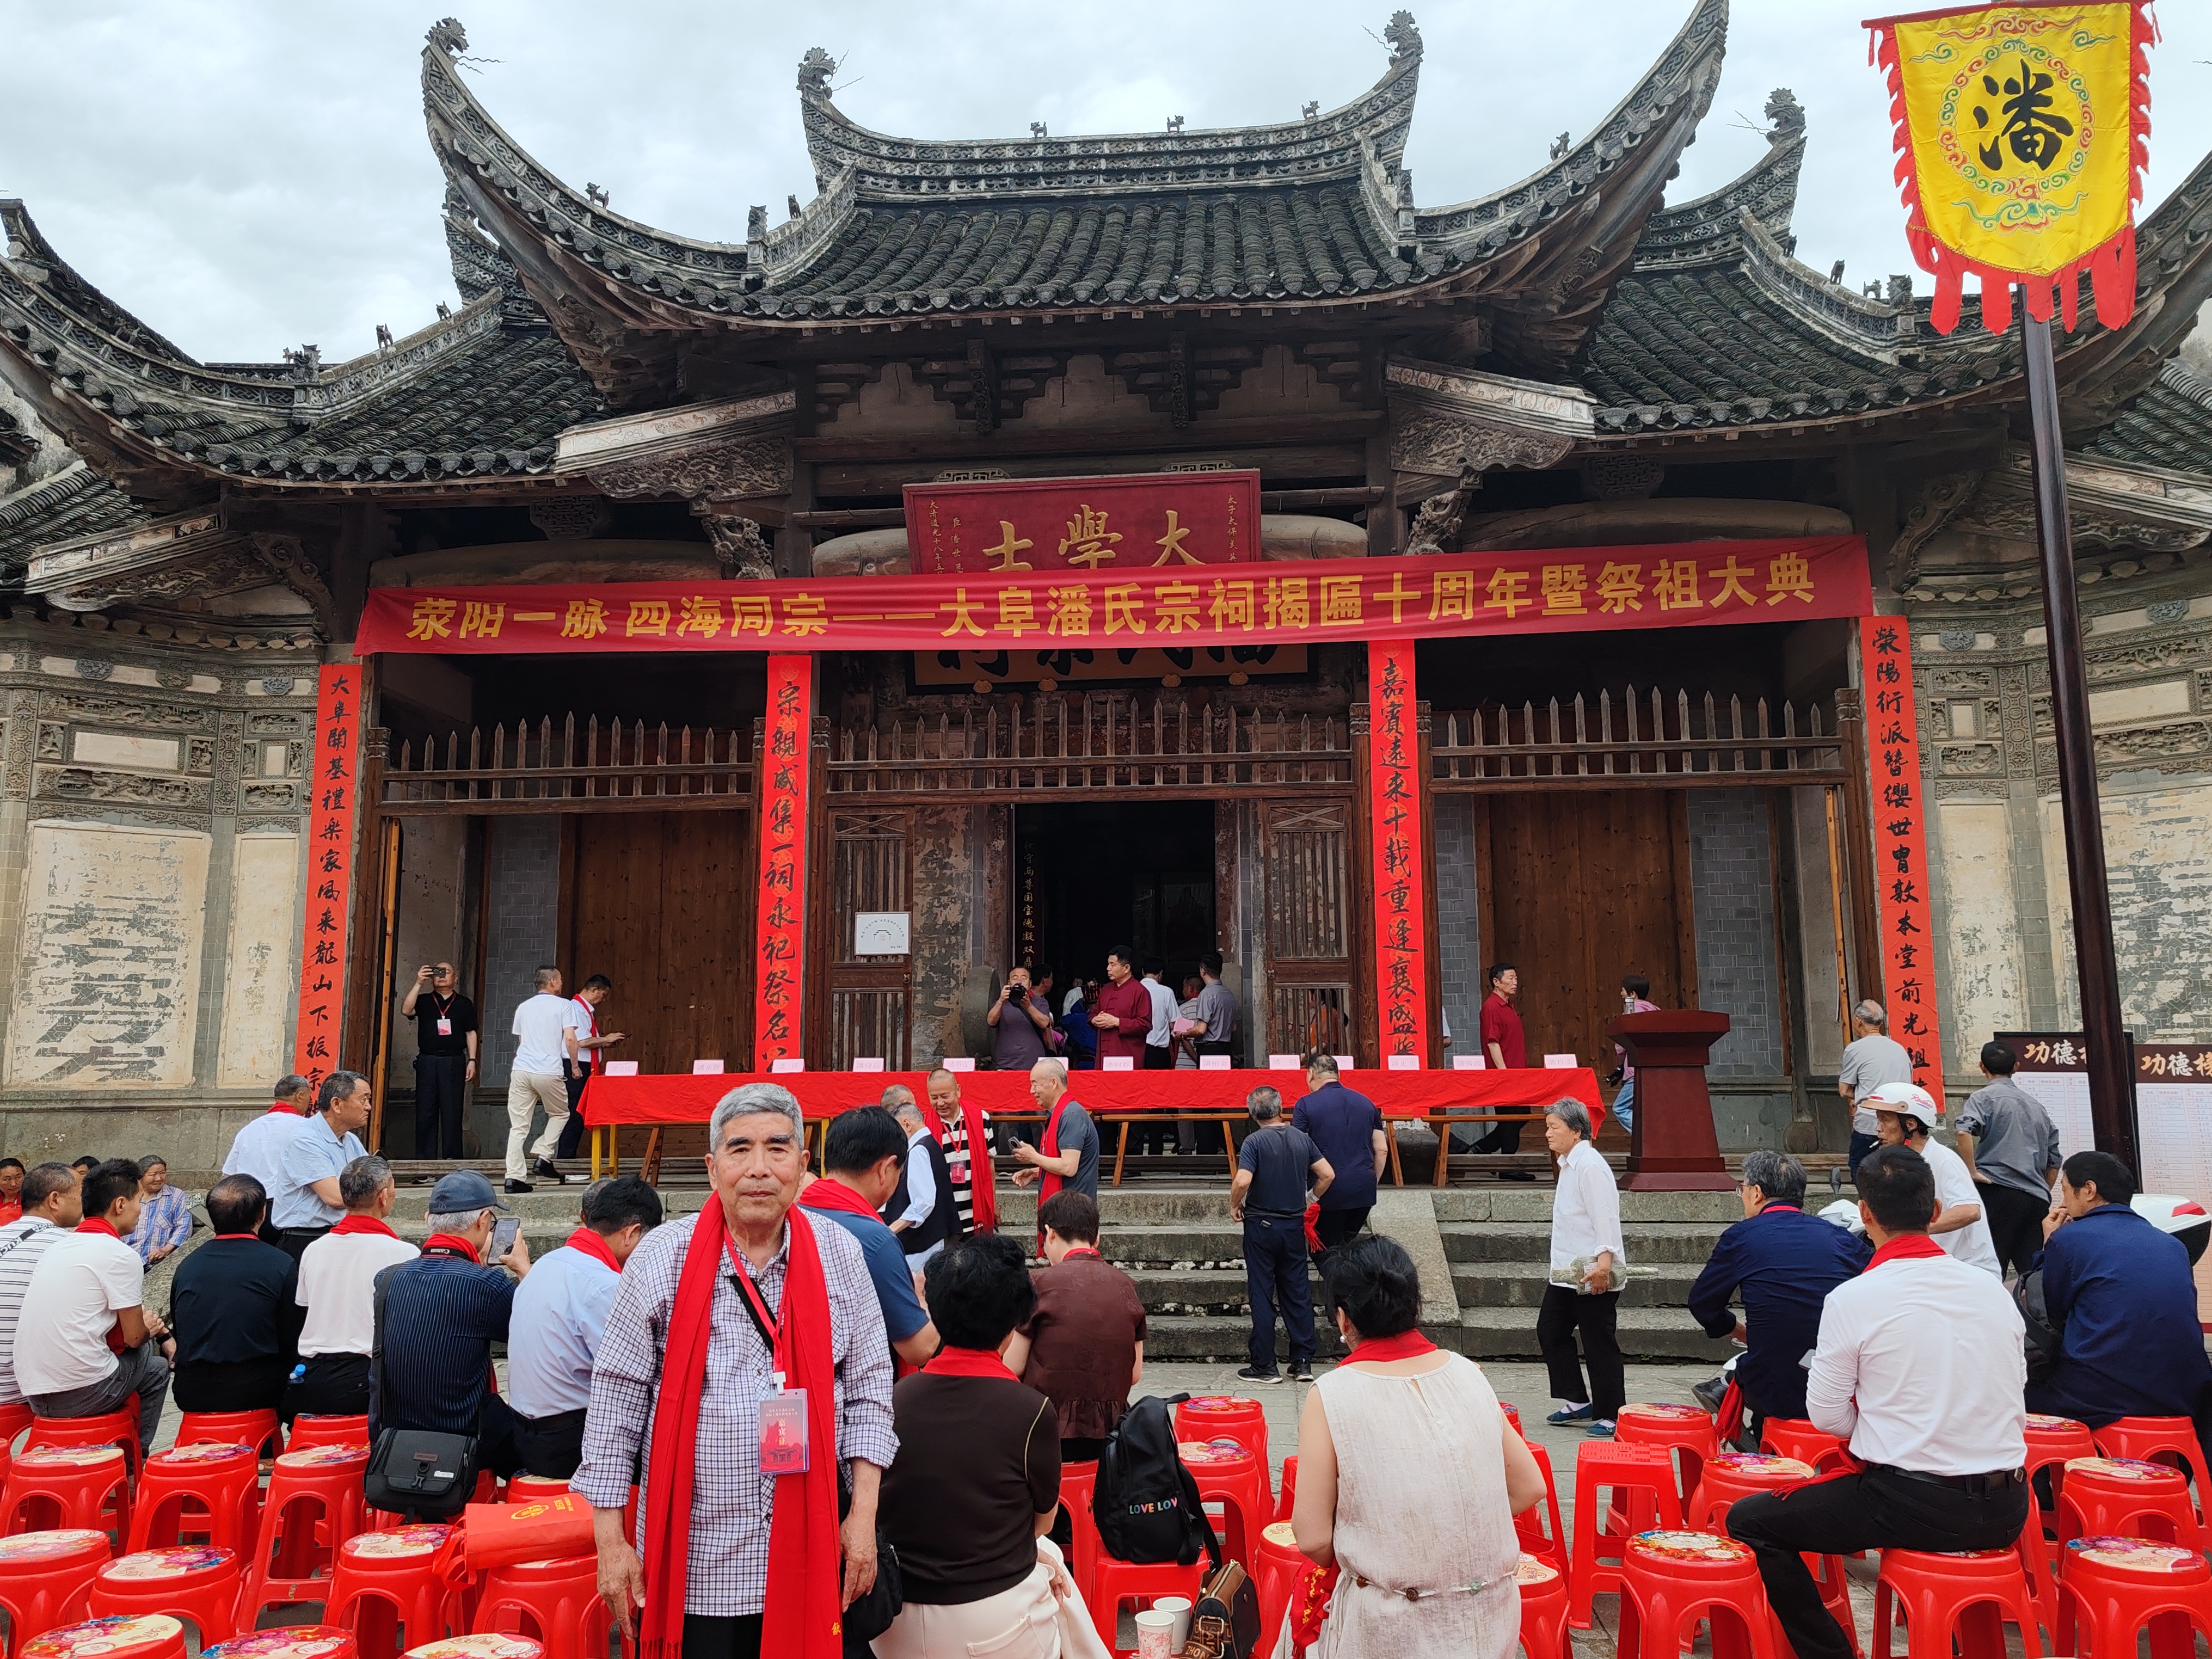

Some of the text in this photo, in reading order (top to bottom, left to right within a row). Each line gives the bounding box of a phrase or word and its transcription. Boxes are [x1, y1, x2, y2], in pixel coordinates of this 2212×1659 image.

[1973, 58, 2073, 170] 潘
[406, 597, 608, 641] 荥阳一脉
[2024, 1039, 2087, 1066] 功德
[1129, 1497, 1178, 1514] LOVE LOV
